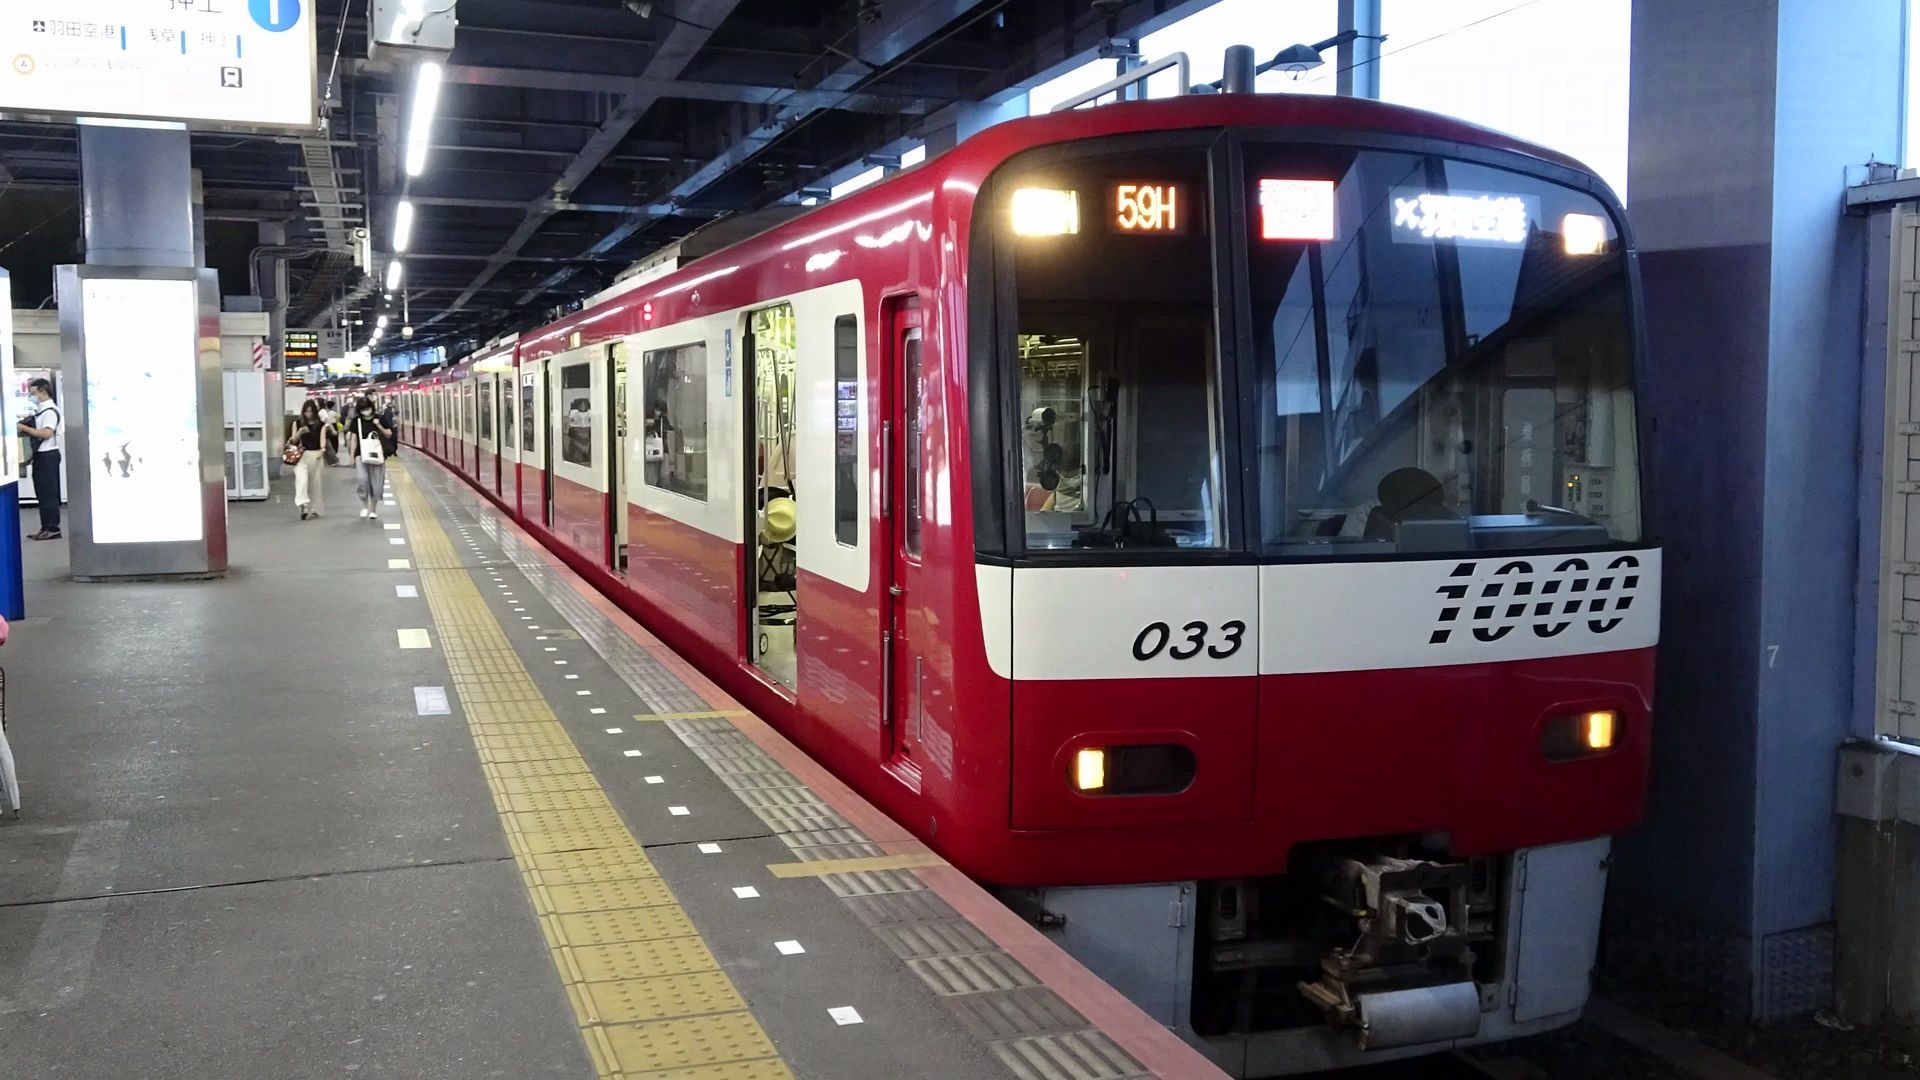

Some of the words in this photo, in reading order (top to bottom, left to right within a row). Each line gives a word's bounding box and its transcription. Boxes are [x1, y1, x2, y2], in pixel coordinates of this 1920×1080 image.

[1117, 185, 1176, 229] 59H
[1429, 555, 1640, 644] 1000
[1132, 620, 1246, 661] 033
[1767, 645, 1780, 669] 7
